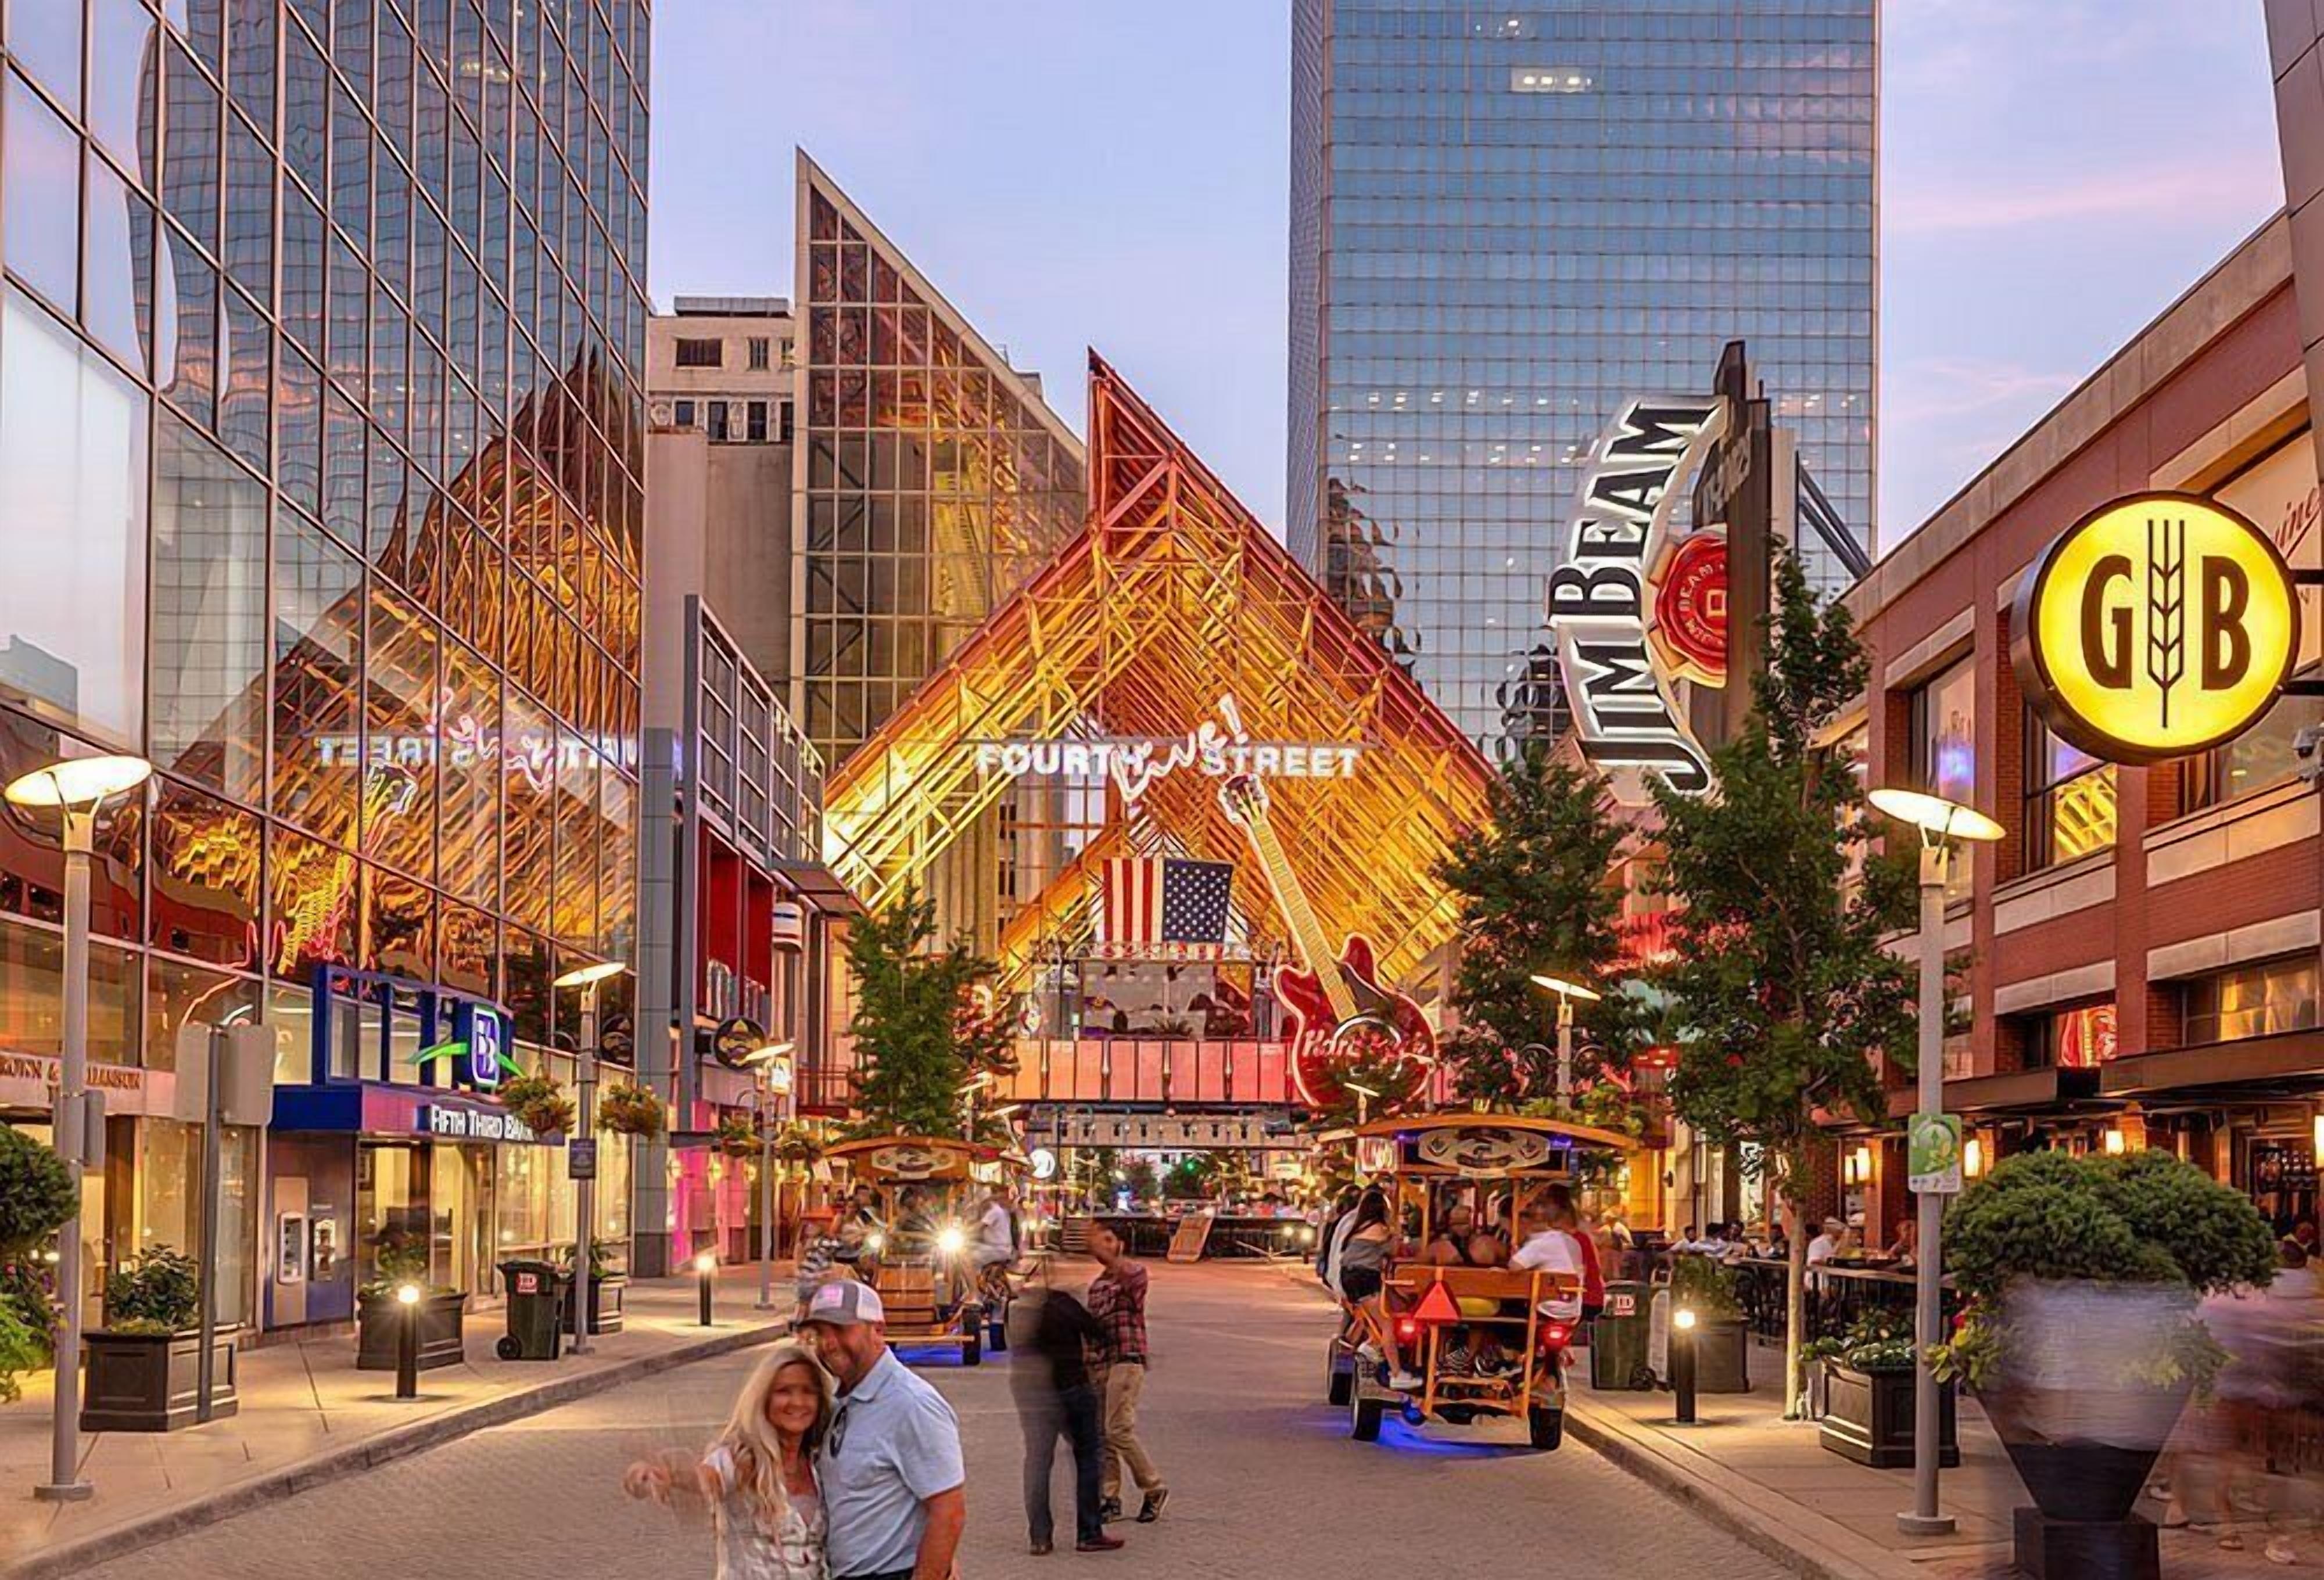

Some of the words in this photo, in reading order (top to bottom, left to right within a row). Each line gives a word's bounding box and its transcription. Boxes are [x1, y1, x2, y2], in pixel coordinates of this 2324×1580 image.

[1548, 401, 1722, 627] BEAM
[976, 743, 1146, 776] FOURTH
[1202, 746, 1362, 778] STREET
[1570, 634, 1712, 796] JIM
[430, 1104, 465, 1135] FIFTH
[468, 1109, 503, 1140] THIRD
